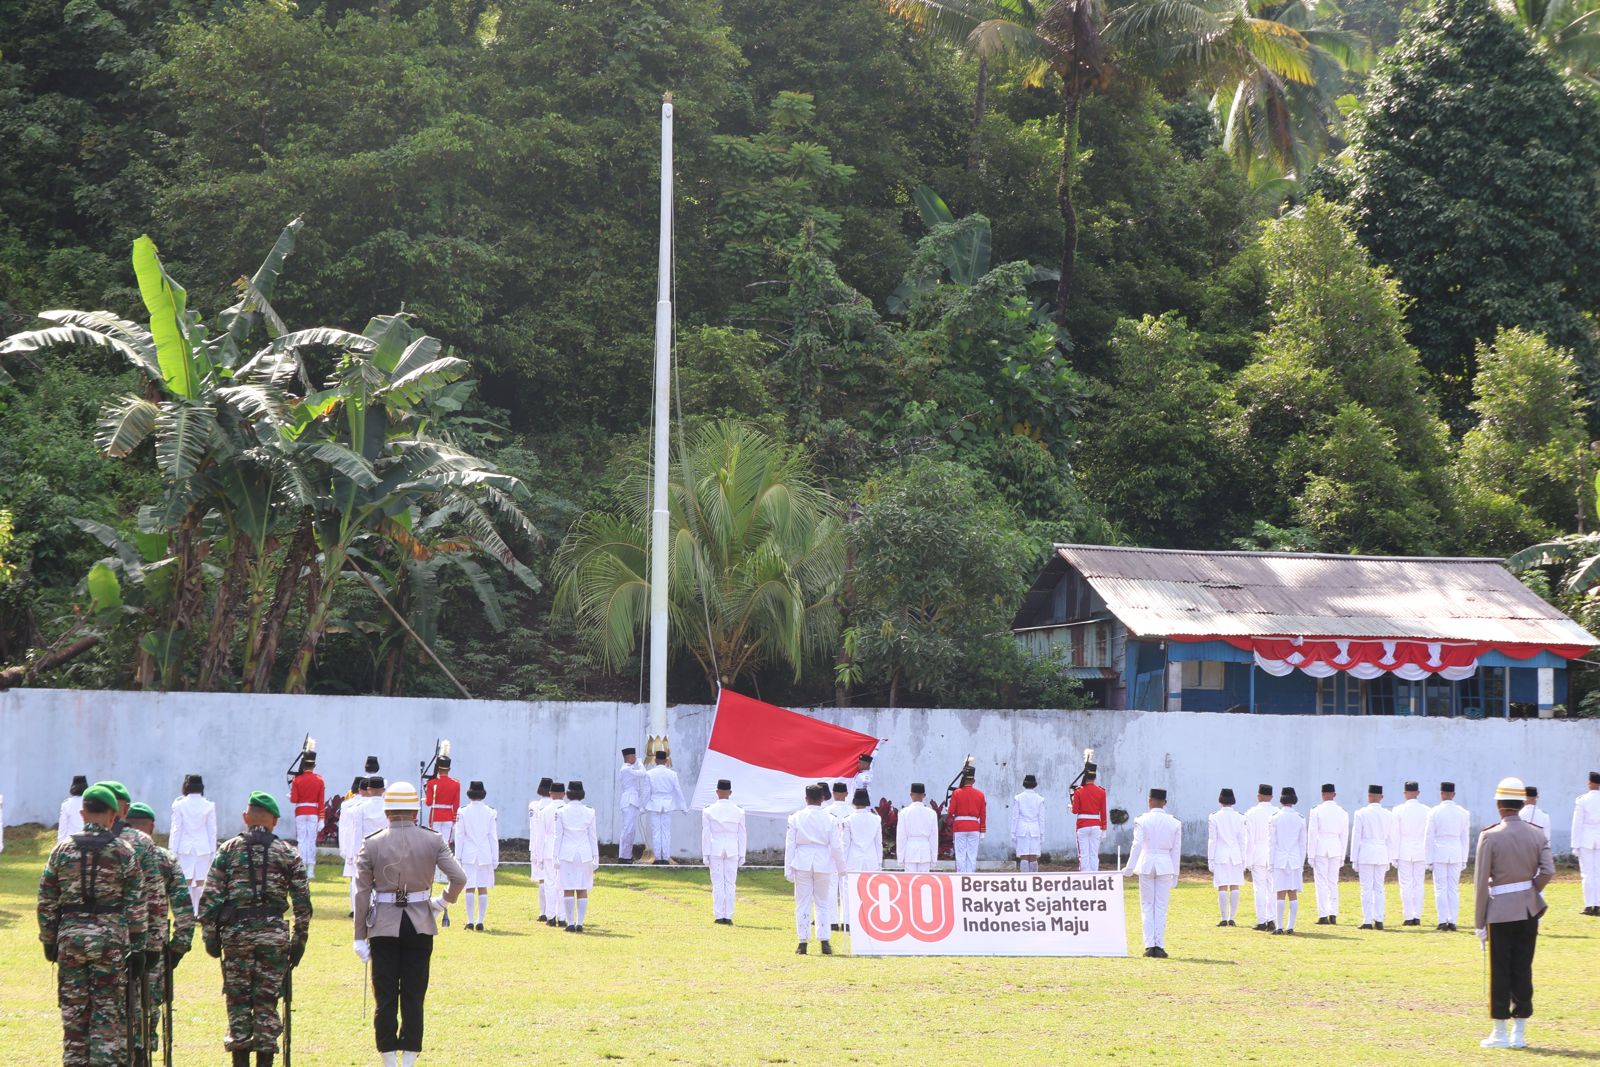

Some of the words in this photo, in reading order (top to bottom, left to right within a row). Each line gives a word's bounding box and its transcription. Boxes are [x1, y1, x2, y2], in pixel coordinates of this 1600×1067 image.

[961, 876, 1027, 892] Bersatu
[1032, 876, 1114, 892] Berdaulat
[857, 873, 955, 942] 80
[962, 897, 1020, 916] Rakyat
[1025, 896, 1107, 915] Sejahtera
[963, 917, 1046, 932] Indonesia
[1051, 917, 1089, 936] Maju
